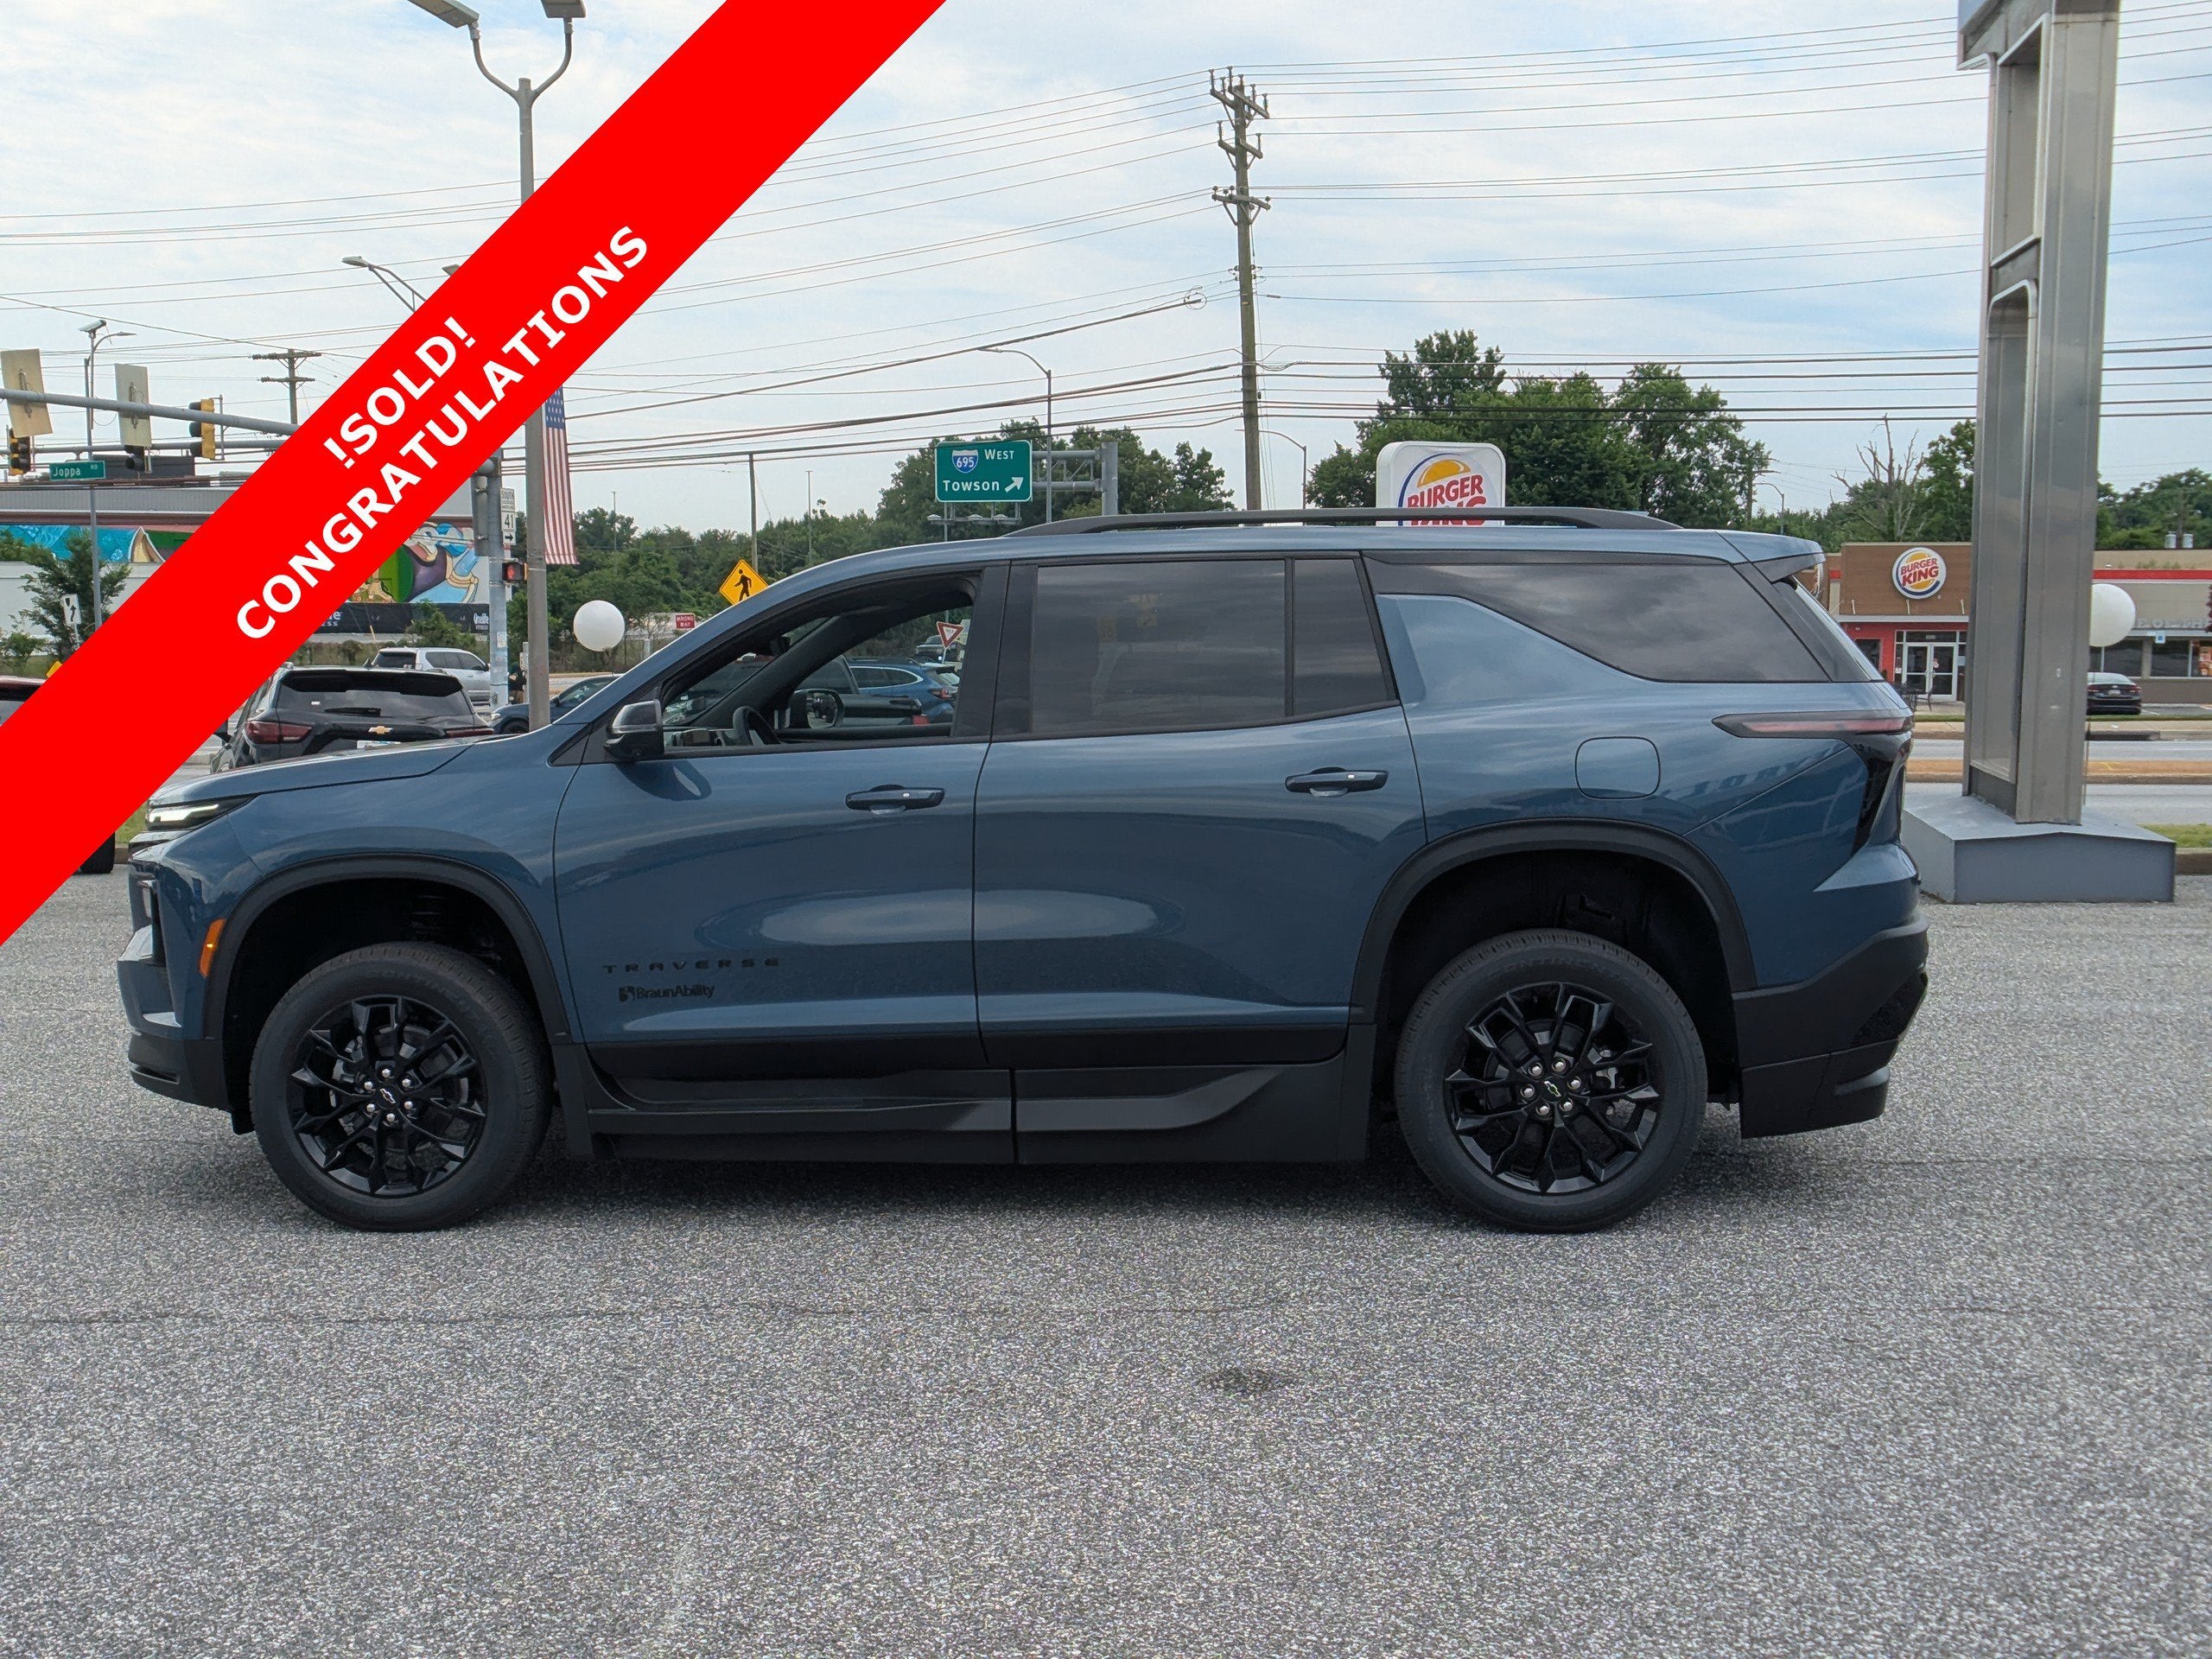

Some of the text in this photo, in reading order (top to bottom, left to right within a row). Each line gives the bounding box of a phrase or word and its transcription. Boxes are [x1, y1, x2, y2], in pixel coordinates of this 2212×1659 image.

[956, 456, 975, 467] 695
[984, 448, 1014, 460] WEST
[53, 467, 81, 477] Joppa
[943, 480, 1000, 492] Towson
[1407, 474, 1484, 507] BURGER
[504, 513, 514, 529] 41
[1900, 557, 1938, 575] BURGER
[1902, 566, 1939, 587] KING
[602, 957, 779, 974] TRAVERSE
[636, 984, 715, 1000] BraunAbility
